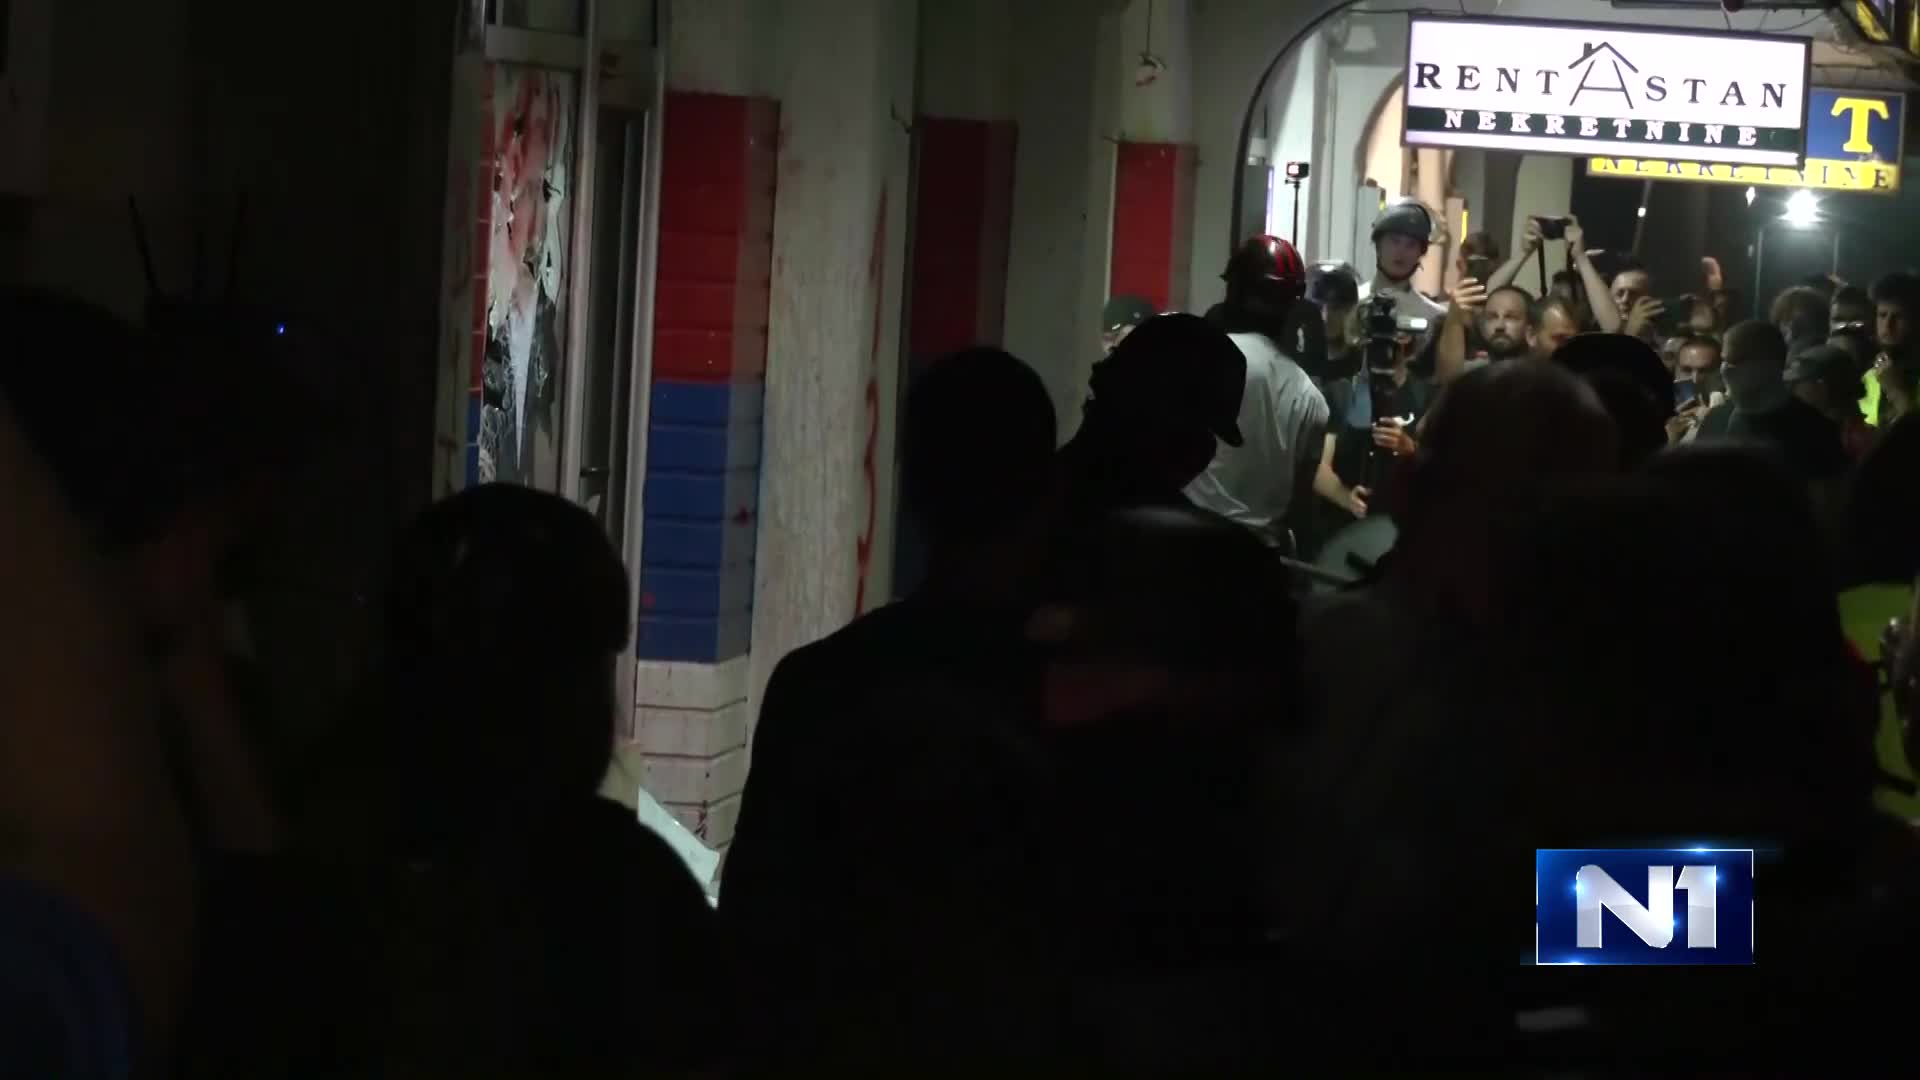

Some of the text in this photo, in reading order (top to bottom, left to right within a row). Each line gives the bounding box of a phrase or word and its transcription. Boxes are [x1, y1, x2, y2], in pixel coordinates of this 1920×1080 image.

[1414, 62, 1560, 96] RENT
[1646, 75, 1787, 109] STAN
[1444, 109, 1758, 147] NEKRETNINE
